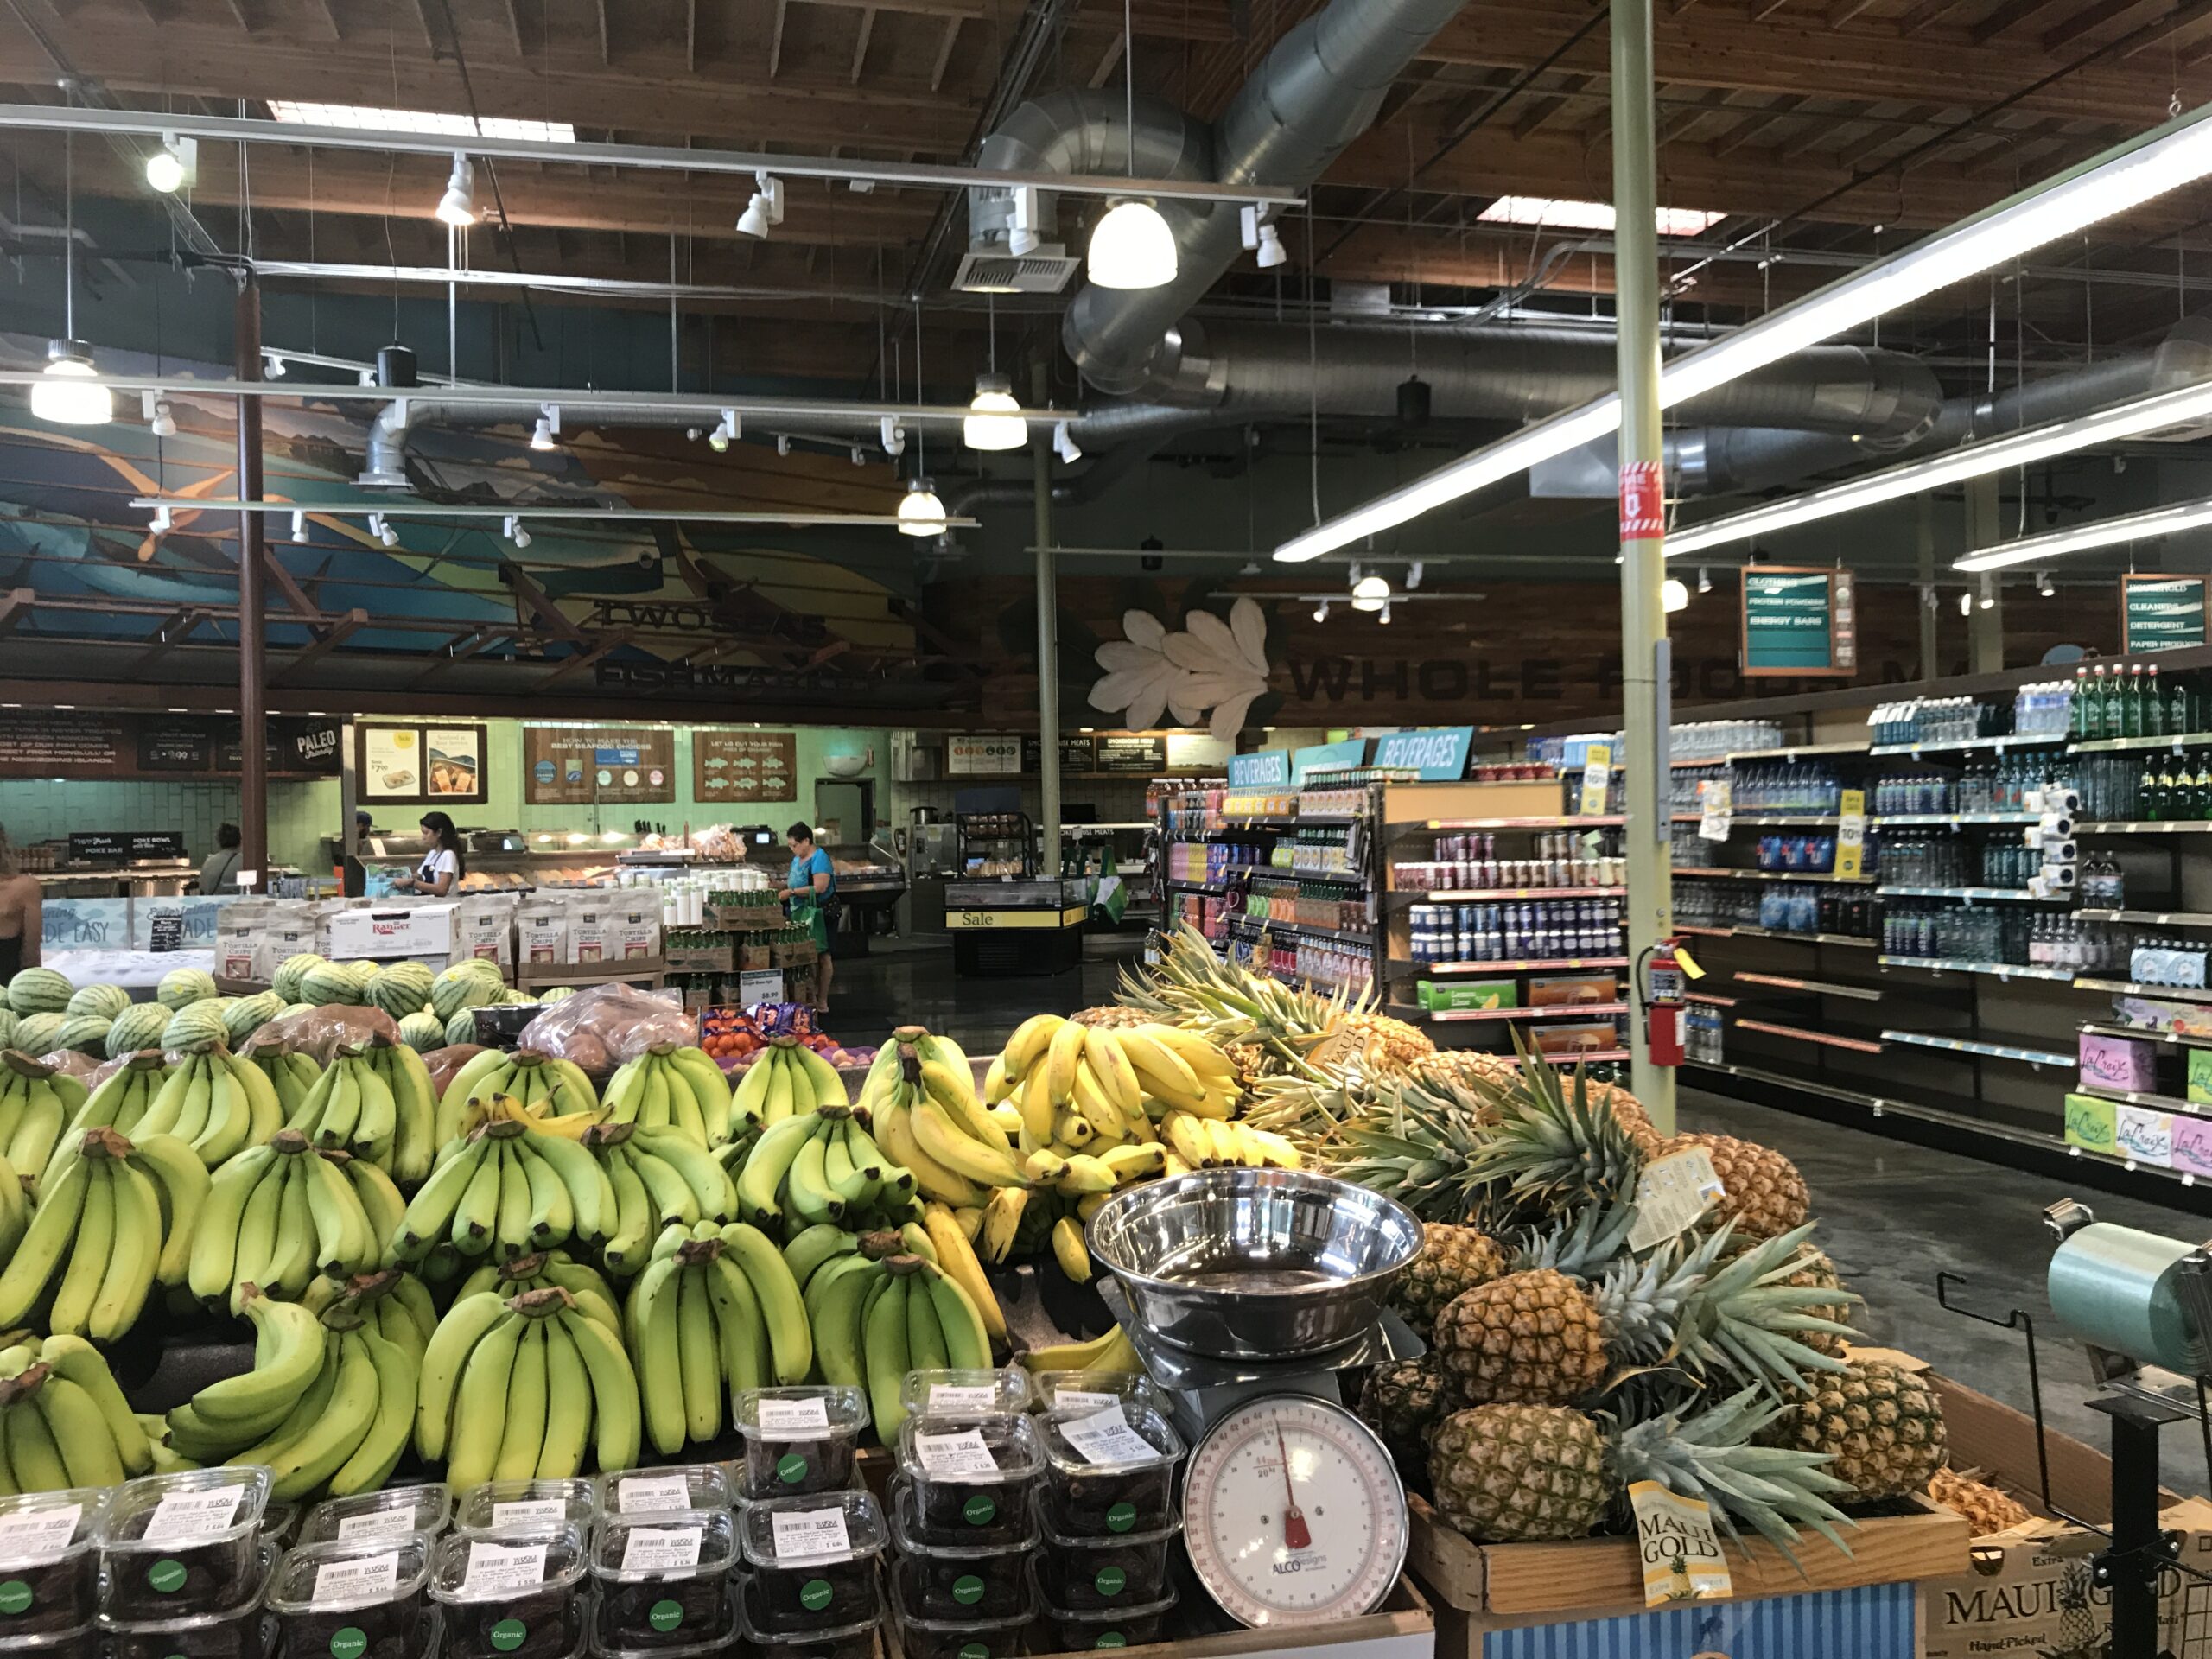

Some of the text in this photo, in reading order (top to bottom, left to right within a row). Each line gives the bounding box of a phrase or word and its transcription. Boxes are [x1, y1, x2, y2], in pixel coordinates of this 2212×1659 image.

[1750, 616, 1822, 625] ENERGY BARS
[1287, 658, 1564, 702] WHOLE
[296, 729, 336, 753] PALEO
[1382, 734, 1459, 768] BEVERAGES
[1234, 755, 1281, 785] BEVERAGES
[146, 902, 223, 921] Entertainin
[962, 912, 994, 925] Sale
[74, 921, 109, 943] EASY
[468, 931, 502, 939] TORTILLA
[779, 1460, 804, 1476] Organic
[966, 1504, 993, 1516] Organic
[1109, 1512, 1135, 1522] Organic
[1639, 1513, 1714, 1542] MAUI
[1643, 1535, 1719, 1563] GOLD
[1272, 1560, 1300, 1575] ALCO
[2032, 1554, 2064, 1567] Extra
[151, 1568, 182, 1584] Organic
[1096, 1577, 1123, 1586] Organic
[802, 1589, 830, 1601] Organic
[955, 1586, 982, 1595] Organic
[1945, 1567, 2181, 1624] MAUI GD
[652, 1611, 680, 1621] Organic
[493, 1630, 523, 1639] Organic
[334, 1639, 364, 1649] Organic
